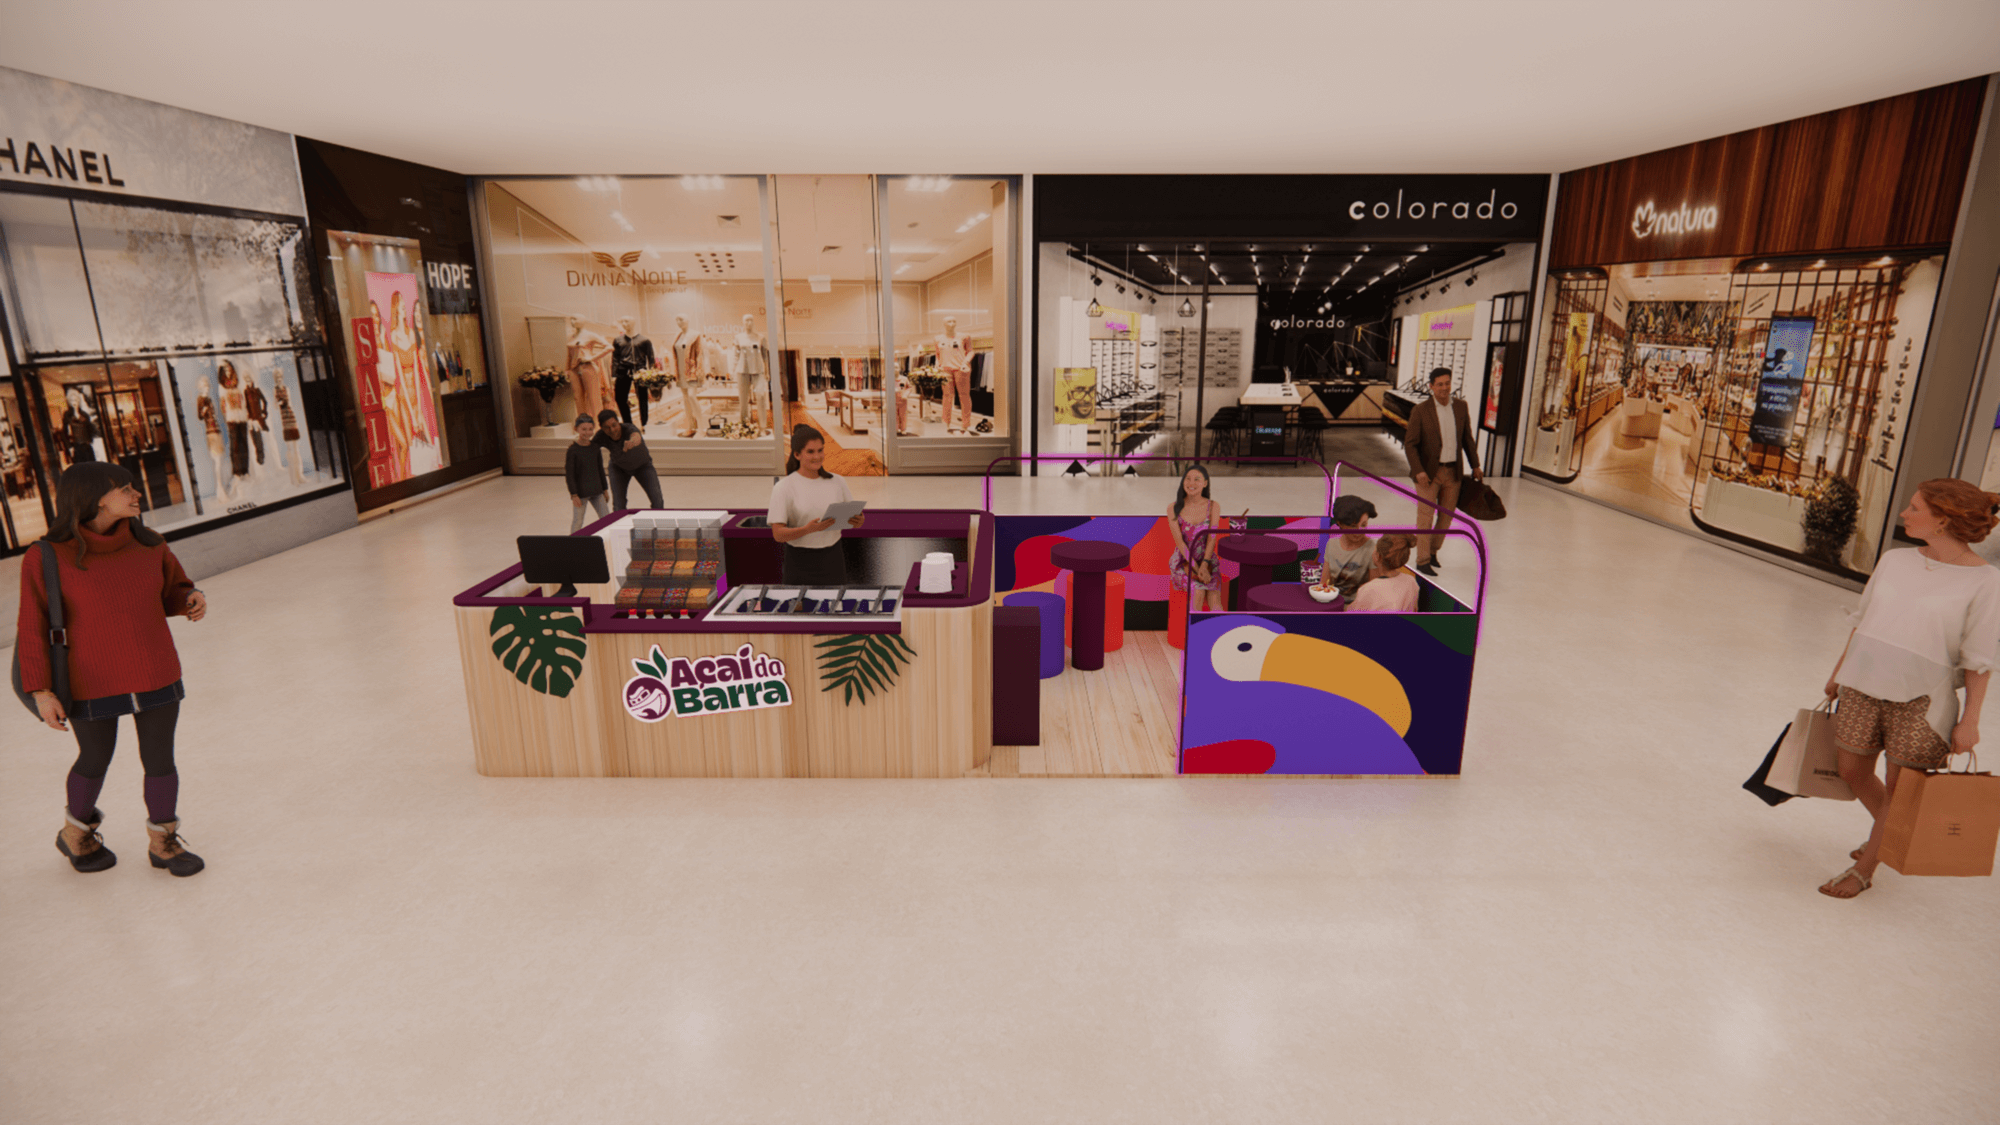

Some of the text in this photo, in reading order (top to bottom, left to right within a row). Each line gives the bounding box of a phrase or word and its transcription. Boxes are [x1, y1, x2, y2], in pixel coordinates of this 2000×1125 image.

[1348, 187, 1518, 221] colorado
[1653, 201, 1718, 236] natura
[426, 260, 471, 290] HOPE
[1270, 314, 1346, 329] colorado
[226, 501, 257, 515] CHANEL
[754, 656, 784, 679] da
[672, 680, 790, 715] Barra
